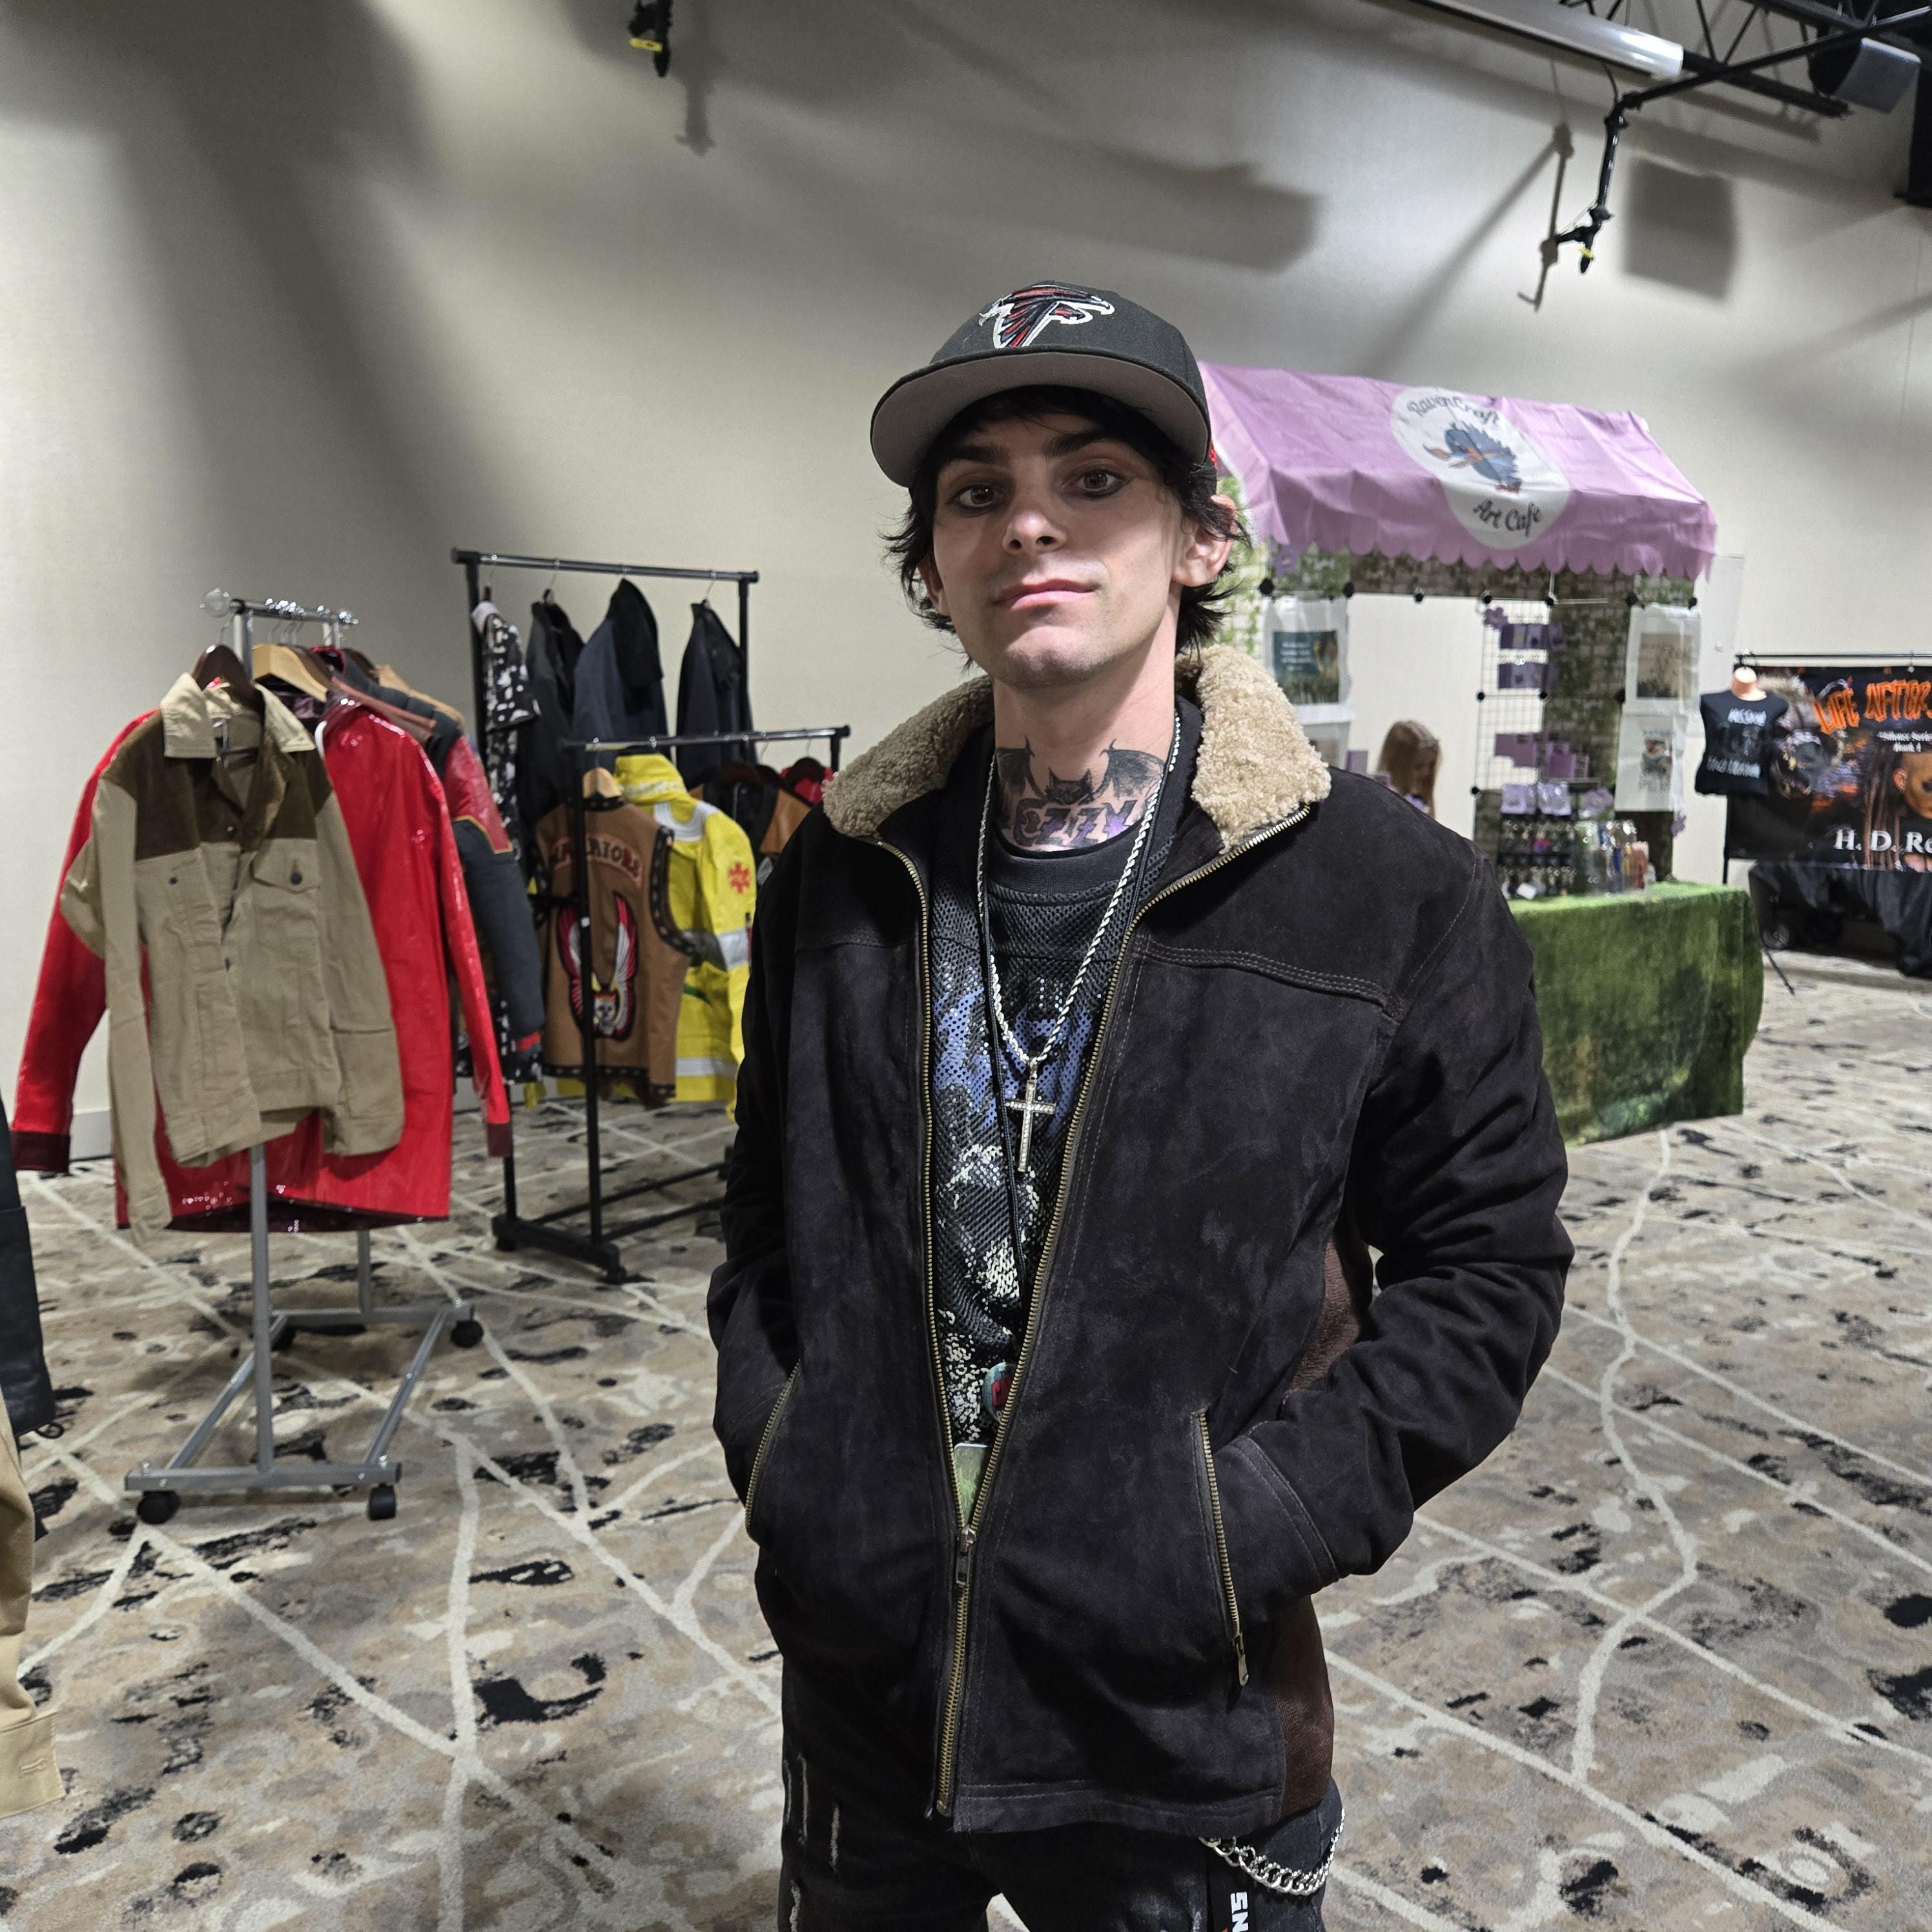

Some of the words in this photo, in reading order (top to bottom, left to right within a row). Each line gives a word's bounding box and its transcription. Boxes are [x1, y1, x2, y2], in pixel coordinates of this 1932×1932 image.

[1474, 499, 1502, 529] Art
[1834, 828, 1862, 851] H.
[1869, 830, 1897, 853] D.
